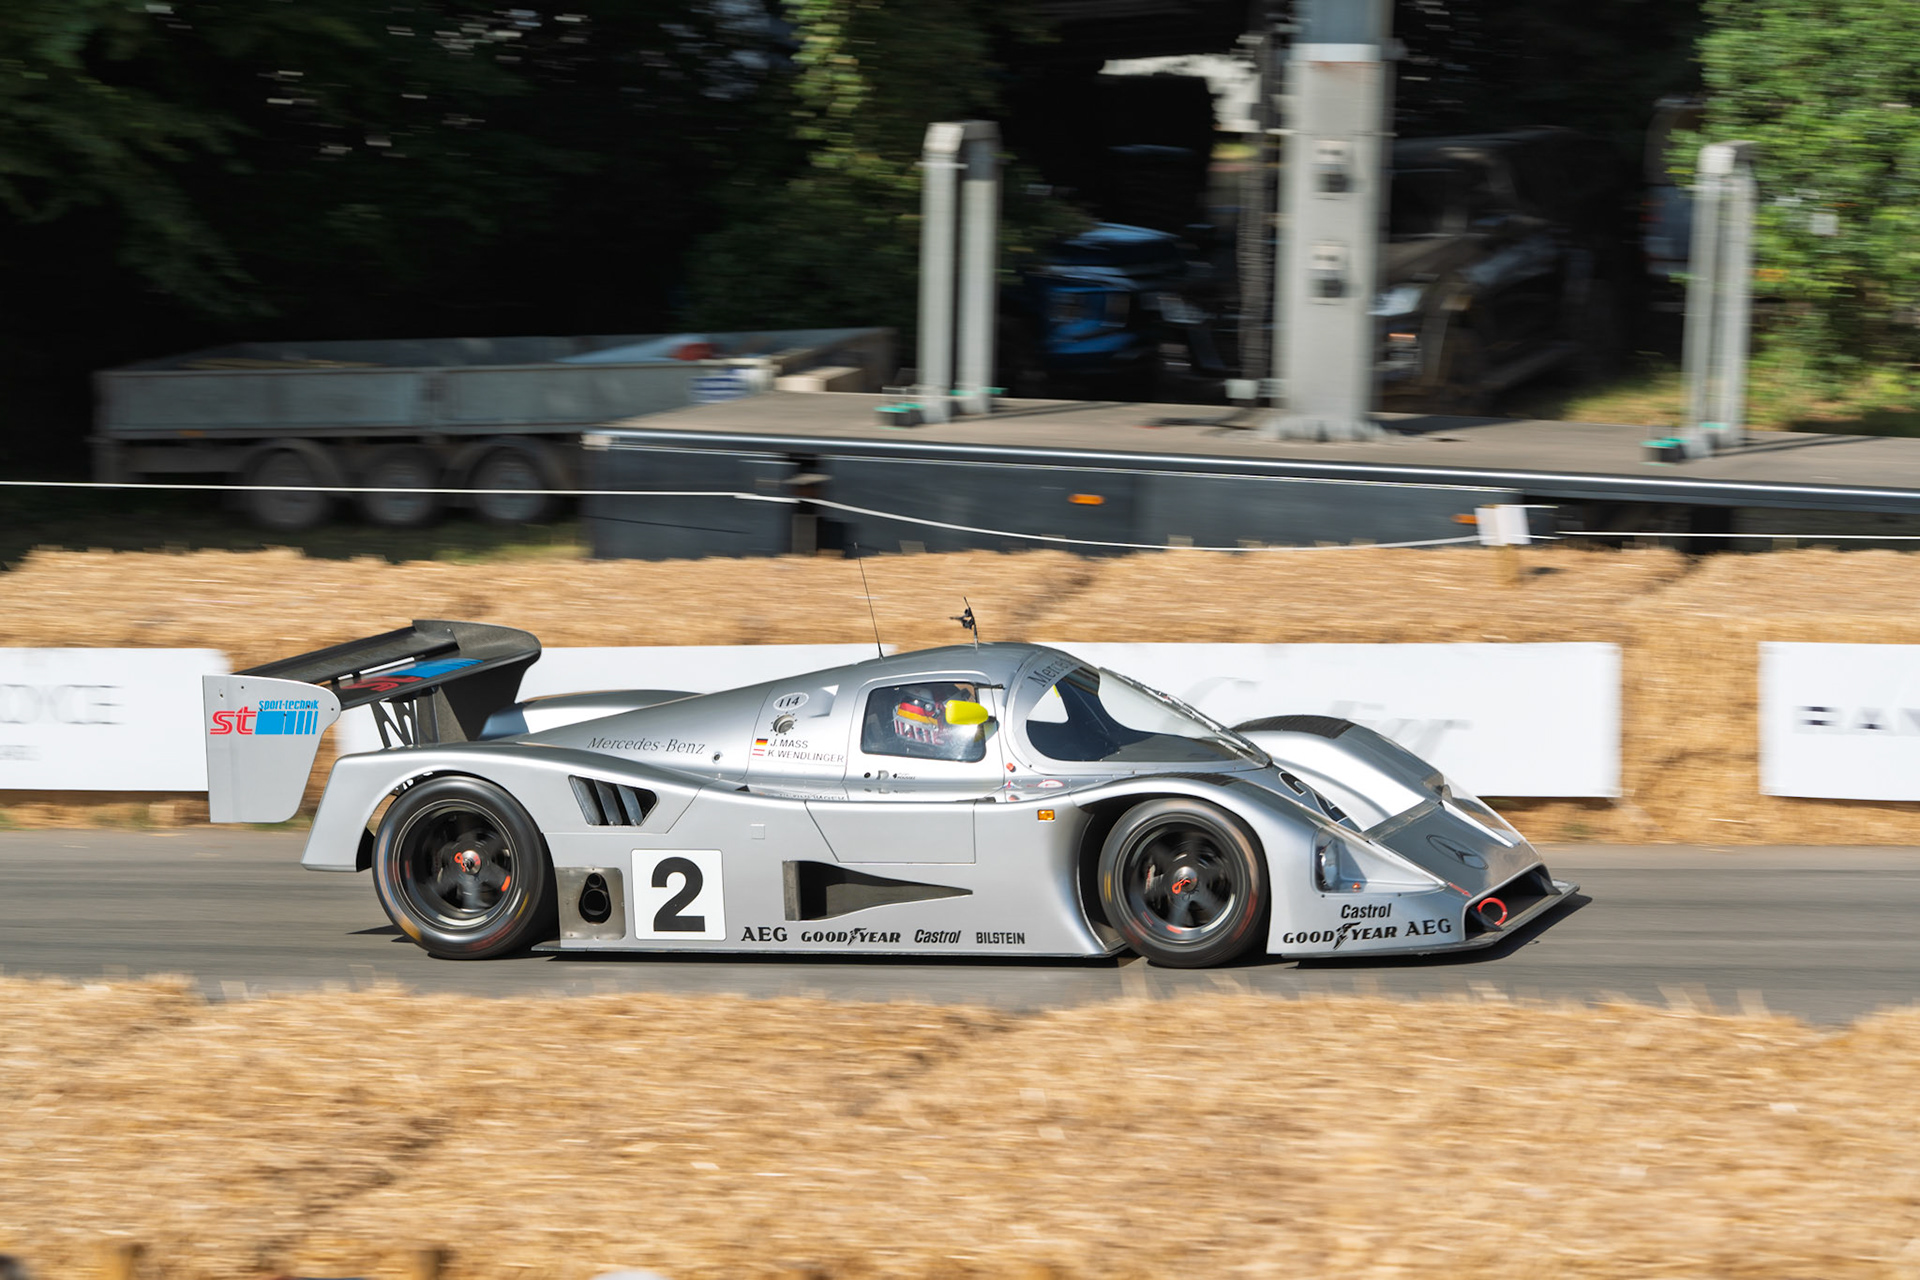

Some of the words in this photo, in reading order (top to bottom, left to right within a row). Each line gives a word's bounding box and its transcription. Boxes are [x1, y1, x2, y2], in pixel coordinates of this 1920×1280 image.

[779, 696, 800, 708] 114
[210, 706, 256, 734] st
[587, 737, 706, 754] Mercedes-Benz
[651, 856, 706, 932] 2
[1341, 903, 1392, 919] Castrol
[741, 926, 788, 942] AEG
[914, 929, 962, 944] Castrol
[976, 932, 1025, 944] BILSTEIN
[1405, 918, 1452, 936] AEG
